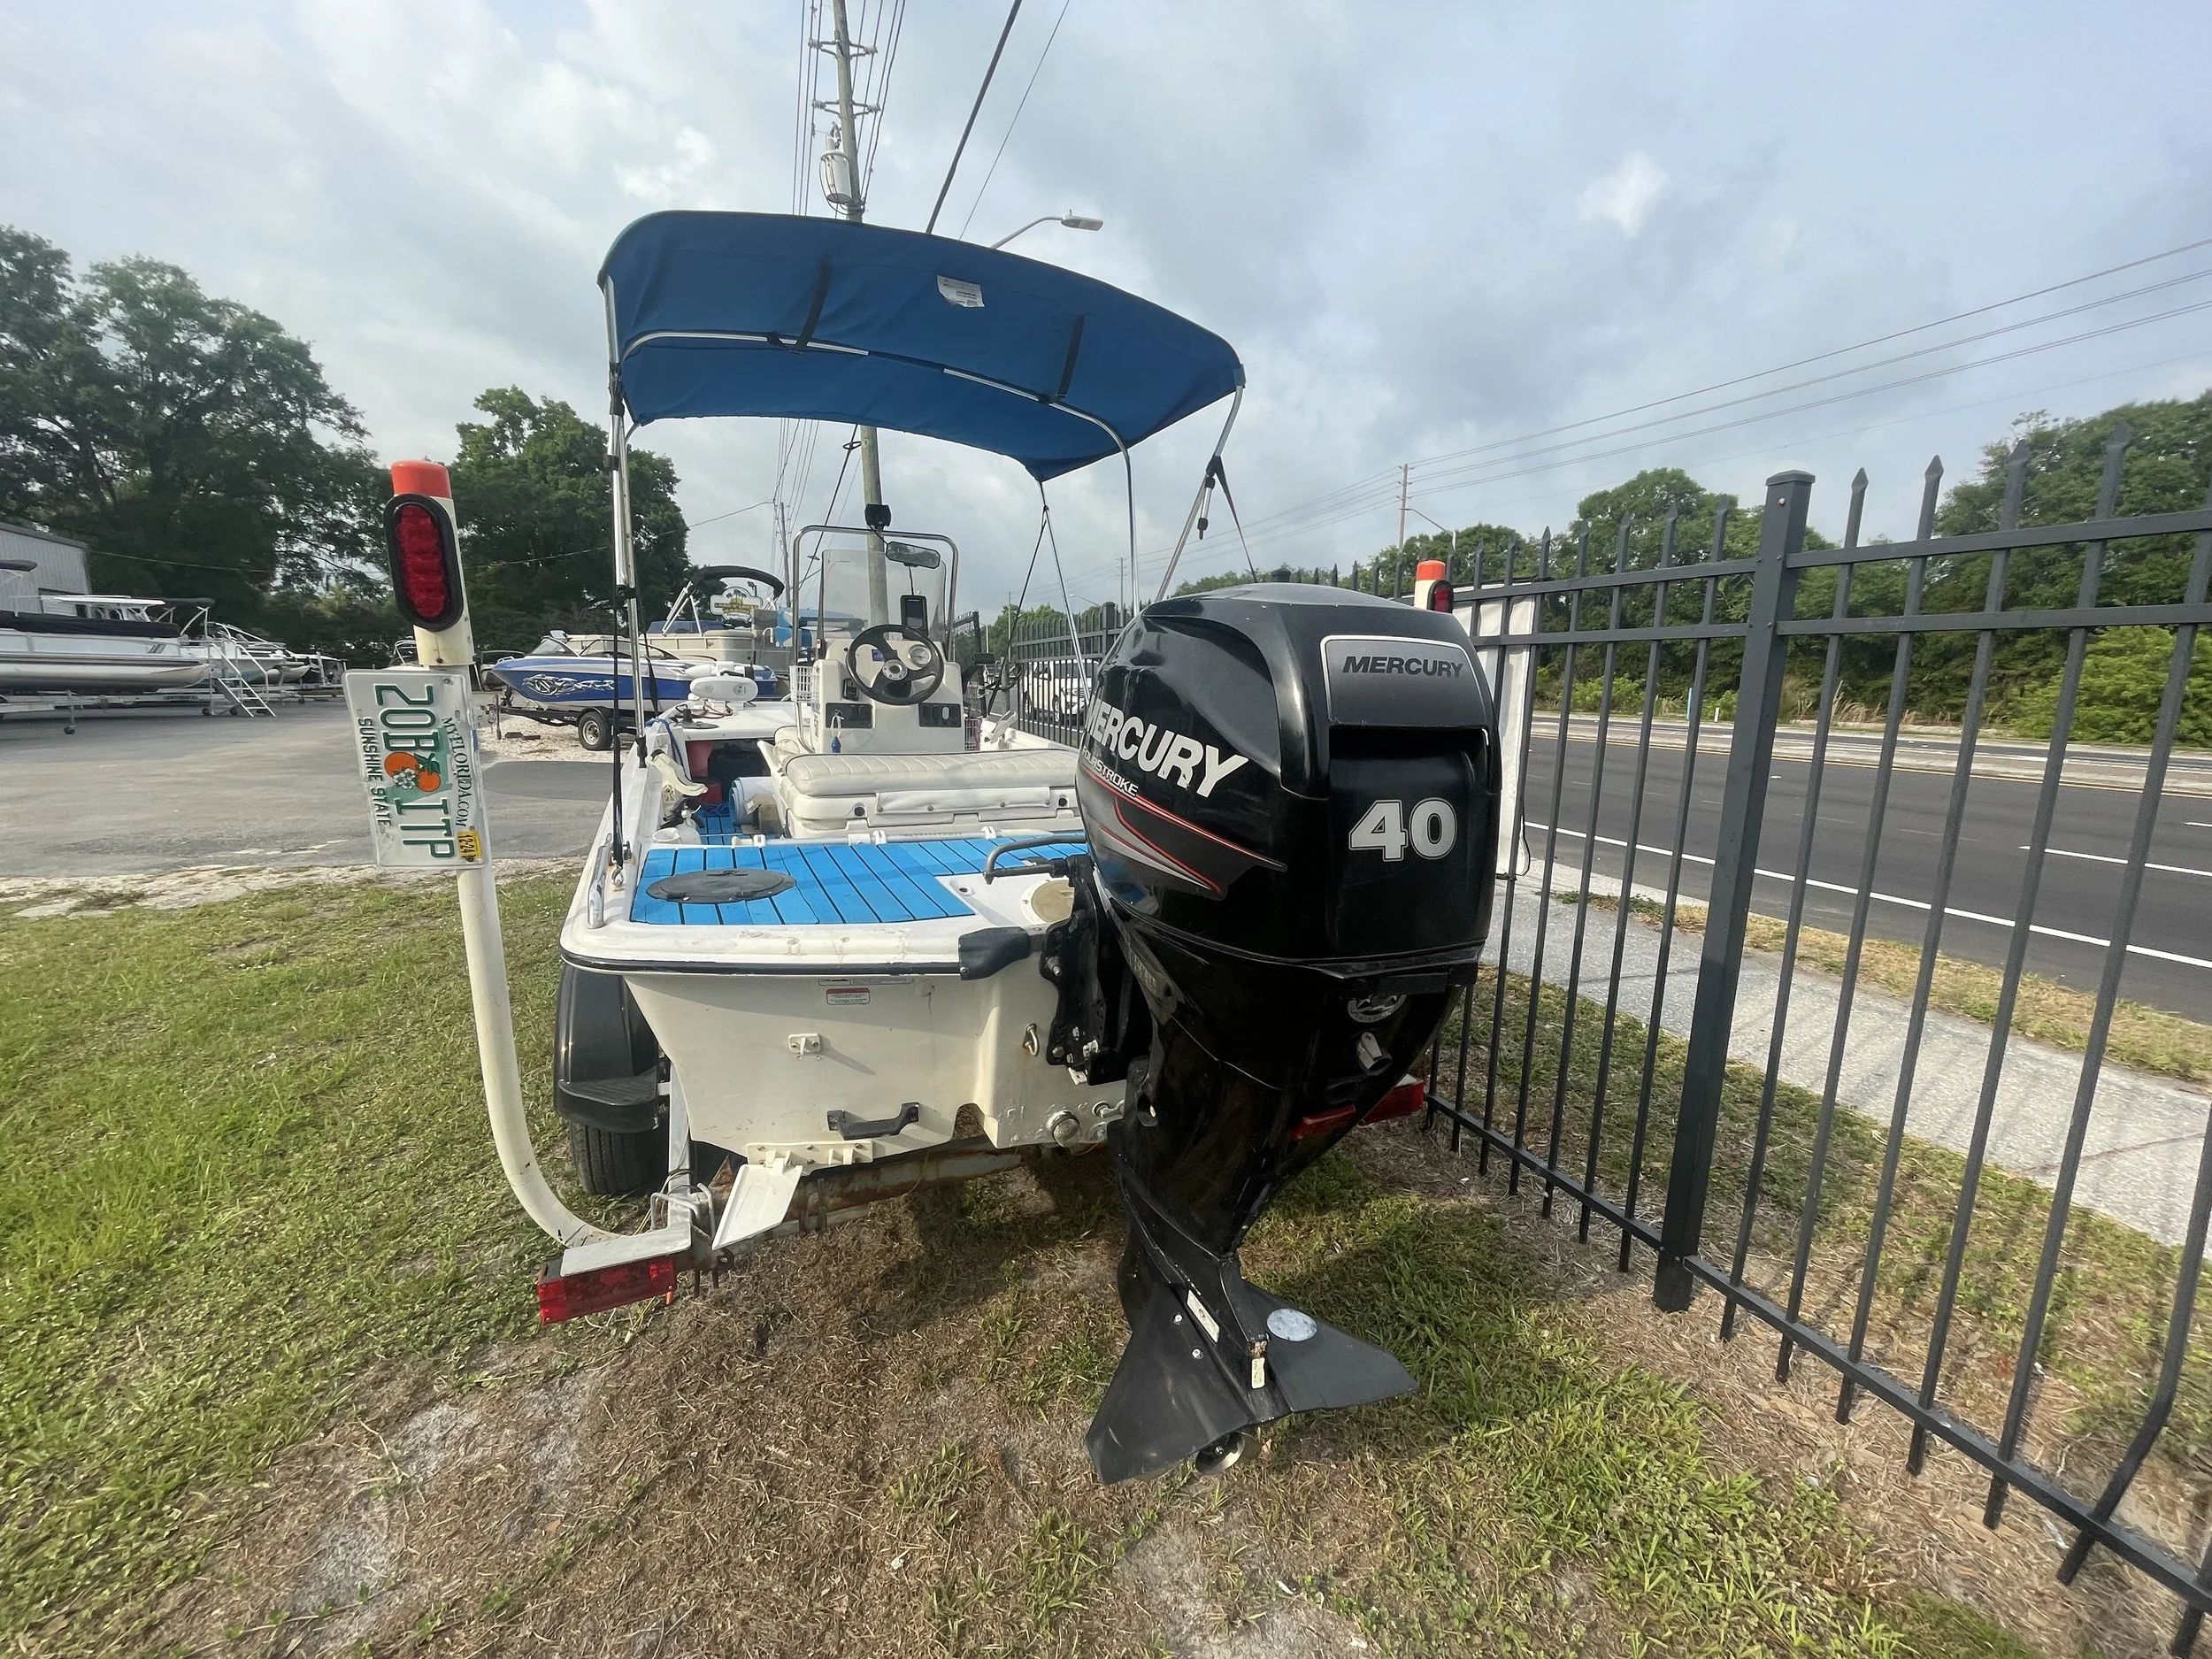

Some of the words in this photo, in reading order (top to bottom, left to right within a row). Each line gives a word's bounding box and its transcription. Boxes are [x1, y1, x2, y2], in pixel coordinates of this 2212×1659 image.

[1342, 655, 1464, 678] MERCURY
[374, 683, 440, 751] 20B
[1085, 696, 1248, 797] MERCURY
[357, 716, 383, 782] SUNSHINE
[370, 787, 392, 826] STATE
[394, 797, 455, 858] ITP
[1348, 797, 1457, 862] 40
